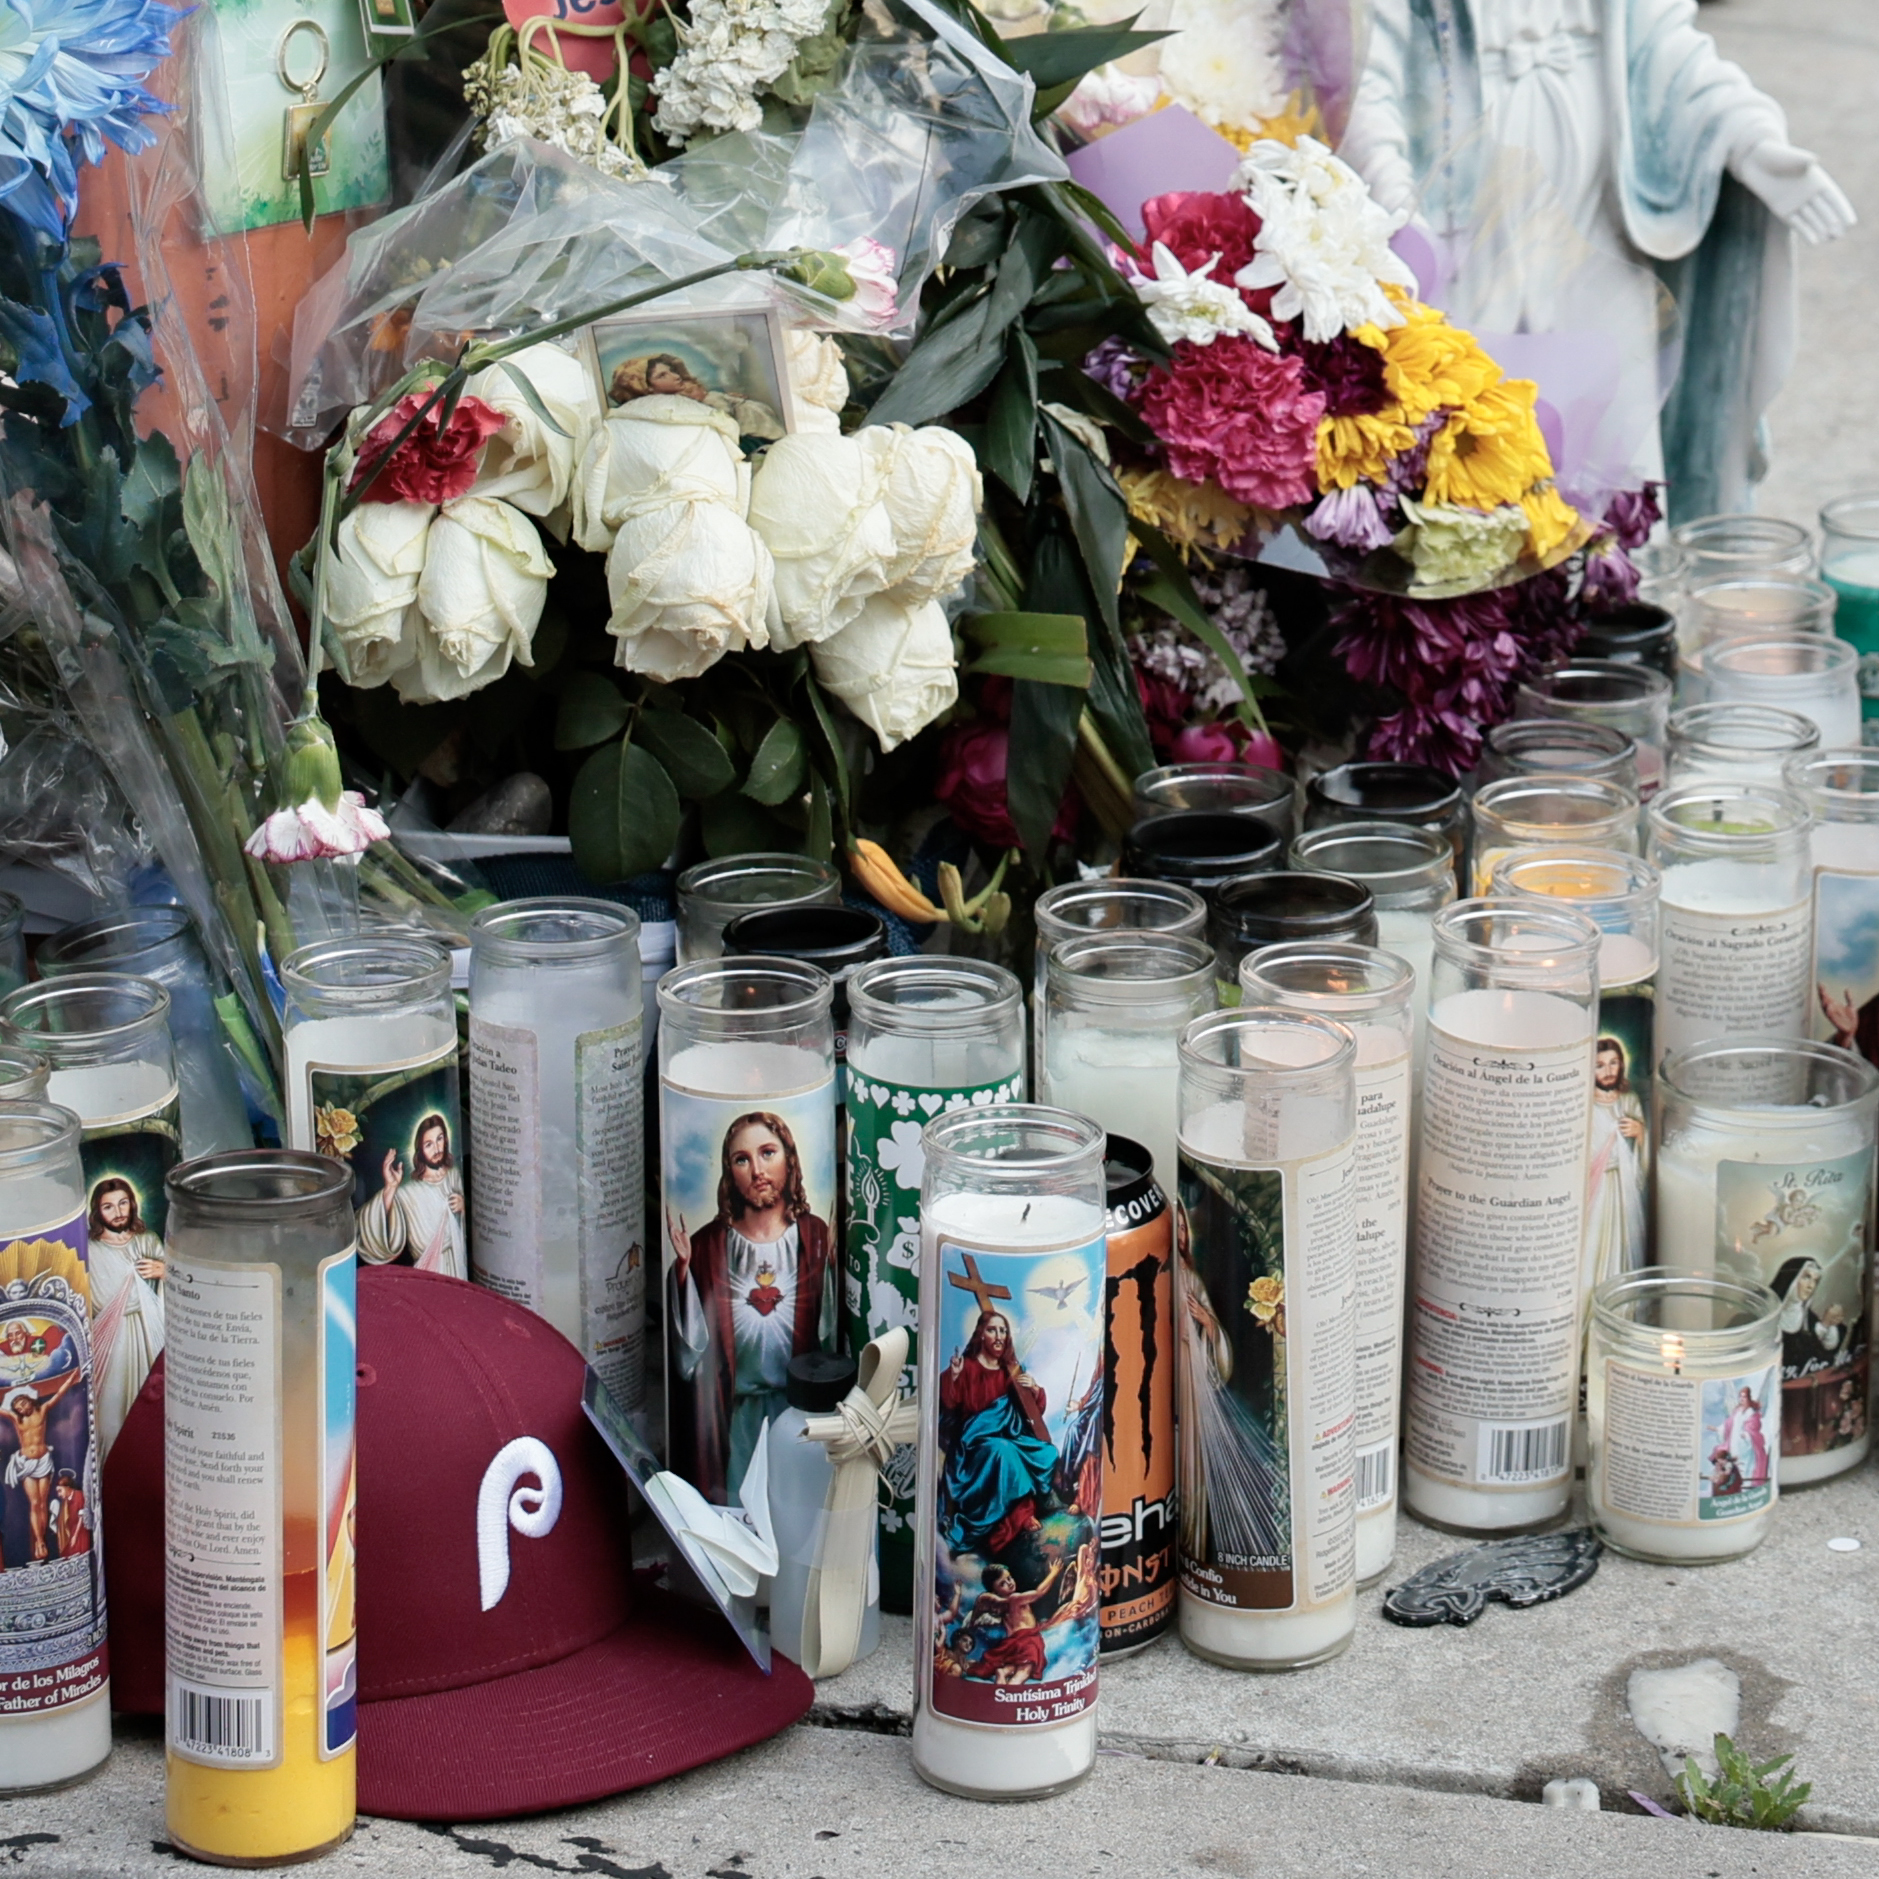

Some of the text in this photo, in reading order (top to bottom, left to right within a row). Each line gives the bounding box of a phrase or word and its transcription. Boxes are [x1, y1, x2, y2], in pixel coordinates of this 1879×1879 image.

[489, 1060, 517, 1074] Tadeo
[1433, 1054, 1580, 1085] Oración al Ángel de la Guarda
[1361, 1092, 1383, 1105] para
[1358, 1101, 1396, 1115] adalupe
[1774, 1169, 1844, 1188] St. Rita
[1428, 1177, 1571, 1208] Prayer to the Guardian Angel
[1106, 1183, 1163, 1228] ECOVER
[1362, 1218, 1377, 1229] the
[1357, 1229, 1386, 1241] alupe
[177, 1284, 201, 1300] Santo
[213, 1310, 263, 1321] de tus fieles
[226, 1324, 252, 1334] Envía,
[209, 1332, 260, 1345] de la Tierra.
[232, 1358, 255, 1368] fieles
[233, 1371, 251, 1382] que,
[231, 1381, 247, 1391] con
[239, 1394, 254, 1403] Por
[174, 1420, 194, 1439] Spirit
[216, 1451, 264, 1461] faithful and
[221, 1463, 242, 1472] forth
[244, 1465, 263, 1475] your
[202, 1473, 264, 1484] you shall renew
[196, 1504, 255, 1520] Holy Spirit, did
[1101, 1488, 1176, 1549] eha
[216, 1520, 232, 1530] that
[235, 1522, 244, 1533] by
[247, 1522, 261, 1531] the
[477, 1436, 562, 1611] P
[206, 1531, 265, 1547] and ever enjoy
[210, 1543, 261, 1555] Lord. Amen.
[1218, 1551, 1287, 1566] 8 INCH CANDLE
[1100, 1545, 1171, 1598] ONST
[1190, 1560, 1223, 1584] Confio
[230, 1584, 256, 1592] alcance
[1201, 1584, 1237, 1604] in You
[1108, 1587, 1169, 1621] PEACH TE
[225, 1641, 260, 1650] things that
[215, 1649, 230, 1658] pets.
[255, 1660, 261, 1668] of
[12, 1677, 30, 1691] de
[33, 1674, 53, 1688] los
[56, 1657, 99, 1684] Milagros
[44, 1690, 58, 1705] of
[61, 1674, 102, 1701] Miracles
[994, 1666, 1097, 1702] Santísima Trinidad
[1016, 1698, 1086, 1721] Holy Trinity
[186, 1738, 251, 1757] 47223 41808
